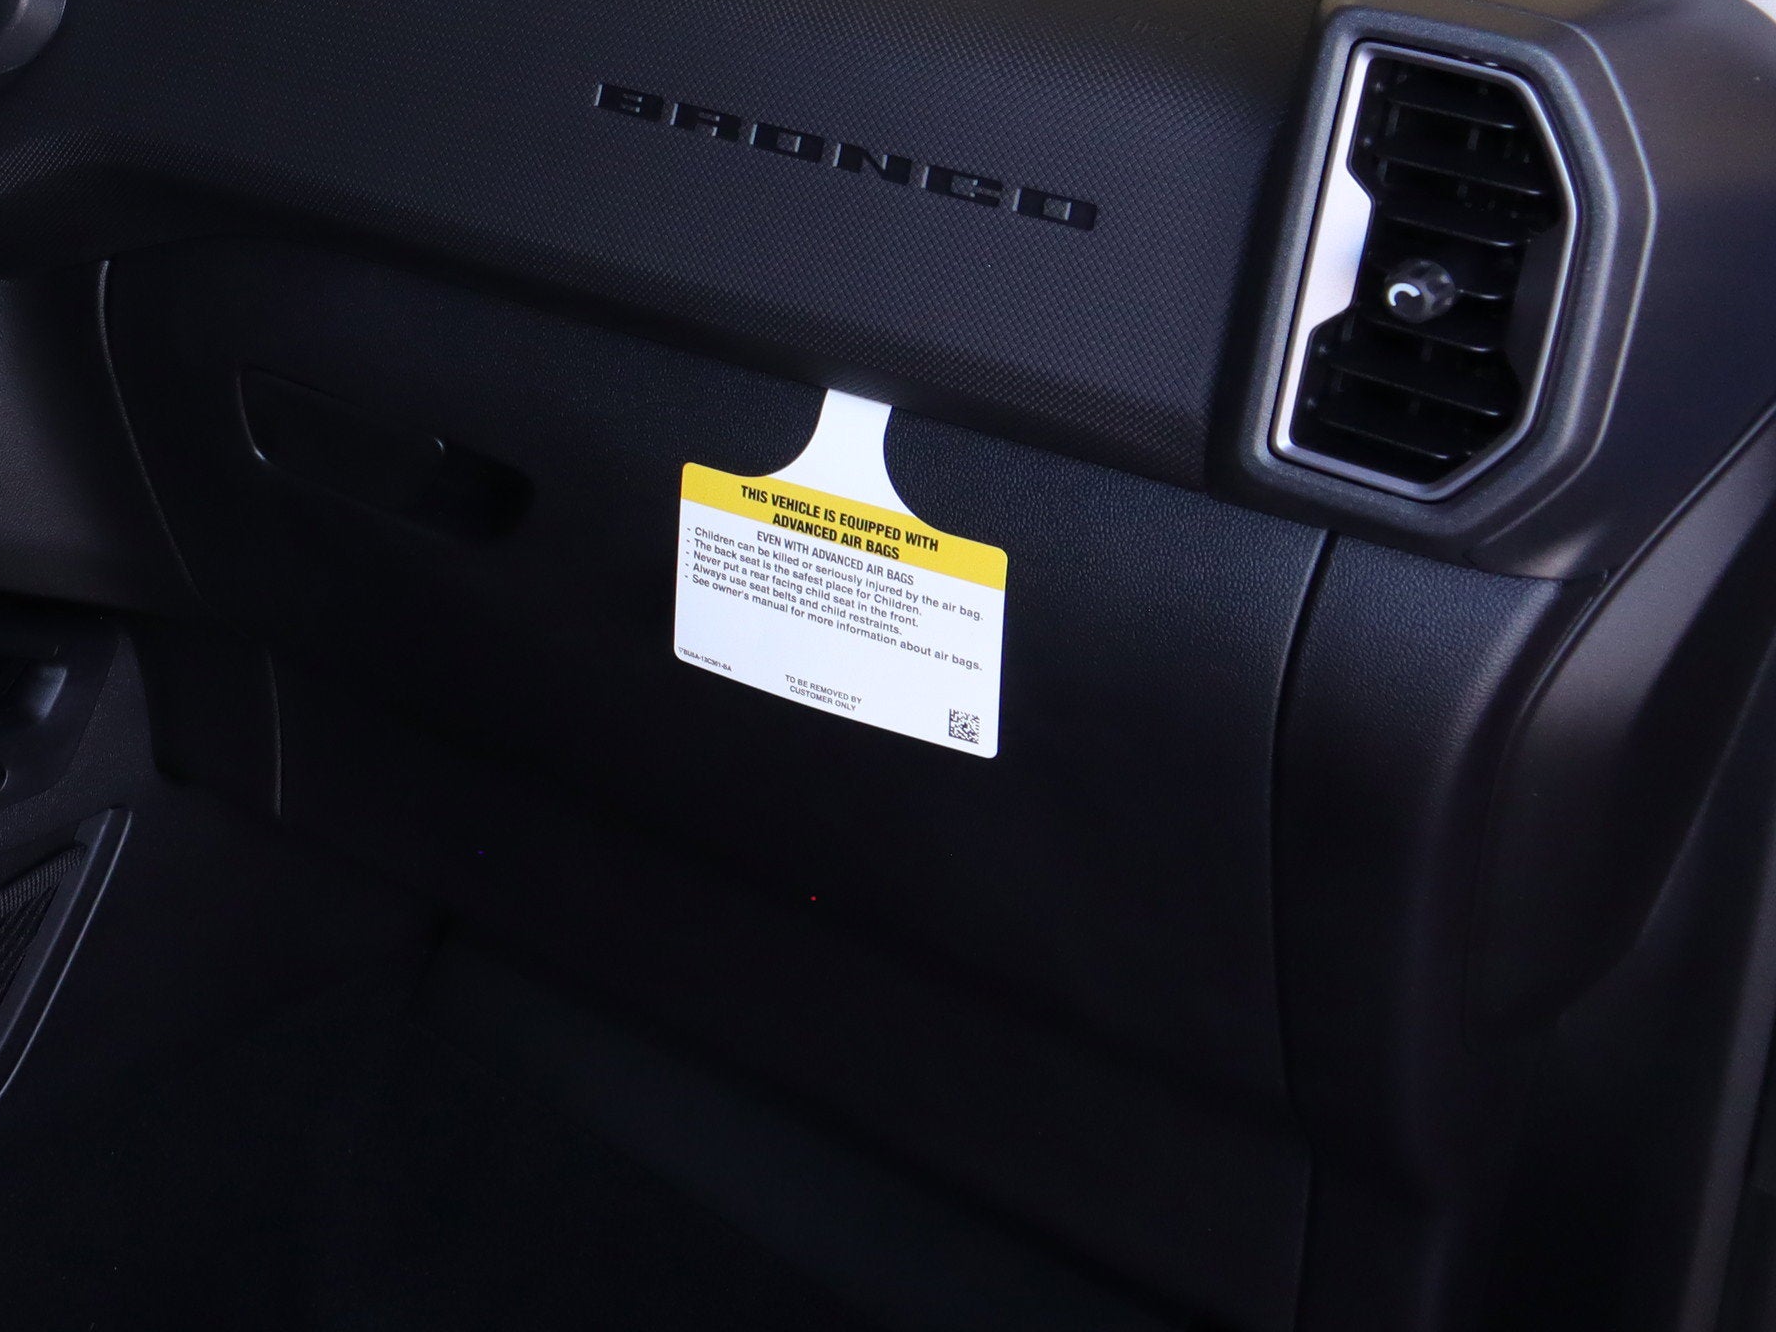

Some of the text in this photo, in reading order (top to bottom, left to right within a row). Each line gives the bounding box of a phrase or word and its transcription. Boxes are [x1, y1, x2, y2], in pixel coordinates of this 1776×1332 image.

[593, 82, 1099, 232] BRONCO
[741, 484, 940, 553] THIS VEHICLE IS EQUIPPED WITH
[772, 513, 900, 560] ADVANCED AIR BAGS
[693, 550, 919, 628] Never put a rear facing child seat in the front.
[694, 526, 984, 622] Children can be killed or seriously injured by the air bag.
[694, 538, 922, 616] The back seat is the safest place for Children.
[756, 530, 915, 586] EVEN WITH ADVANCED AIR BAGS
[692, 573, 984, 672] See owner's manual for more information about air bags.
[693, 562, 903, 636] Always use seat belts and child restraints.
[784, 673, 863, 705] TO BE REMOVED BY
[789, 685, 857, 712] CUSTOMER ONLY
